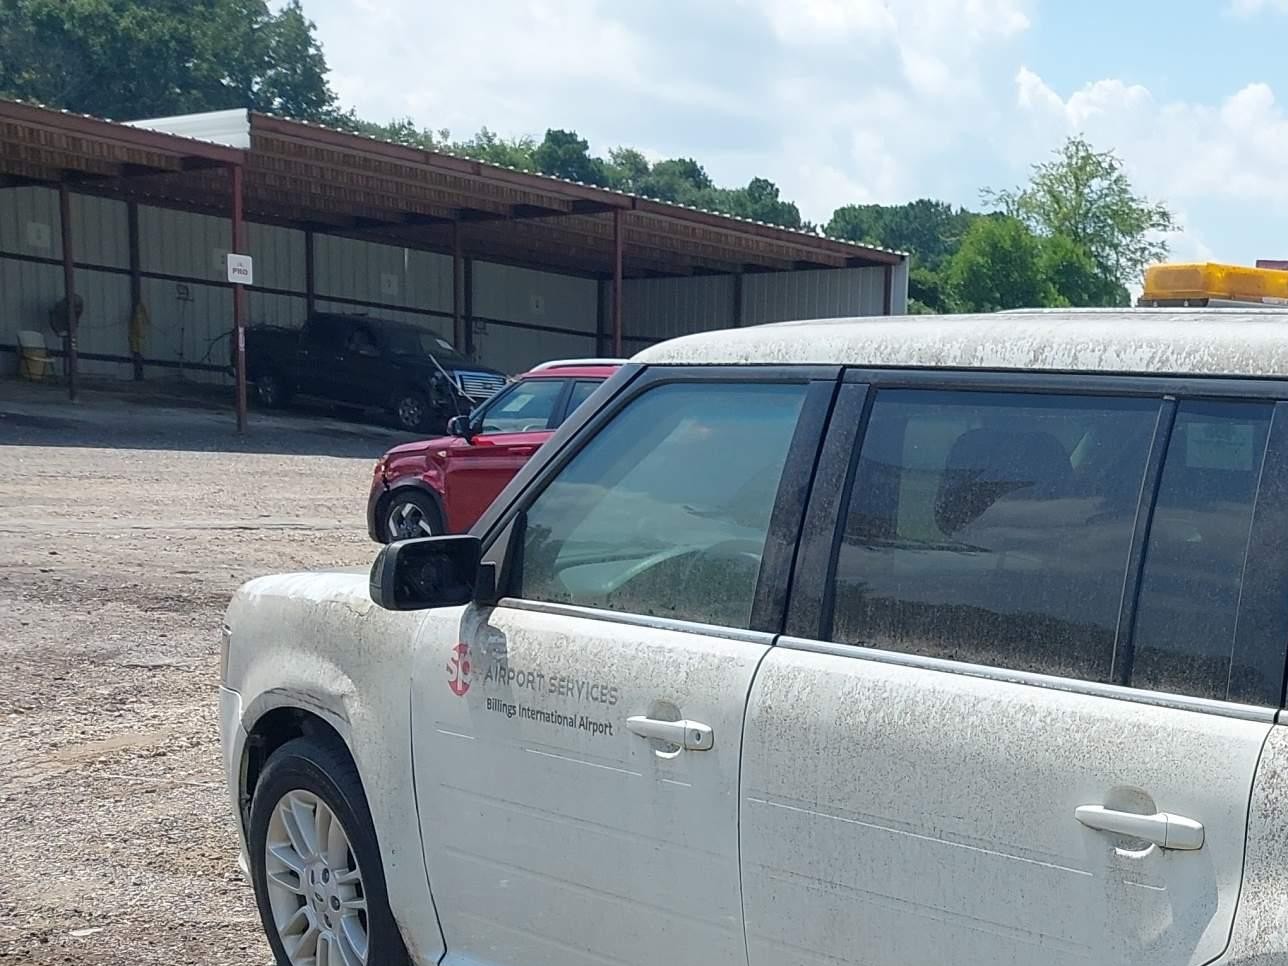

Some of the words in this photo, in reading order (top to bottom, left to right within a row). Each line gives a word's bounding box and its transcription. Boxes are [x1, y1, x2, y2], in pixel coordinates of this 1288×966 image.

[484, 665, 544, 691] AIRPORT
[548, 676, 618, 705] SERVICES
[486, 697, 517, 718] Billings
[518, 703, 577, 728] International
[578, 714, 614, 736] Airport
